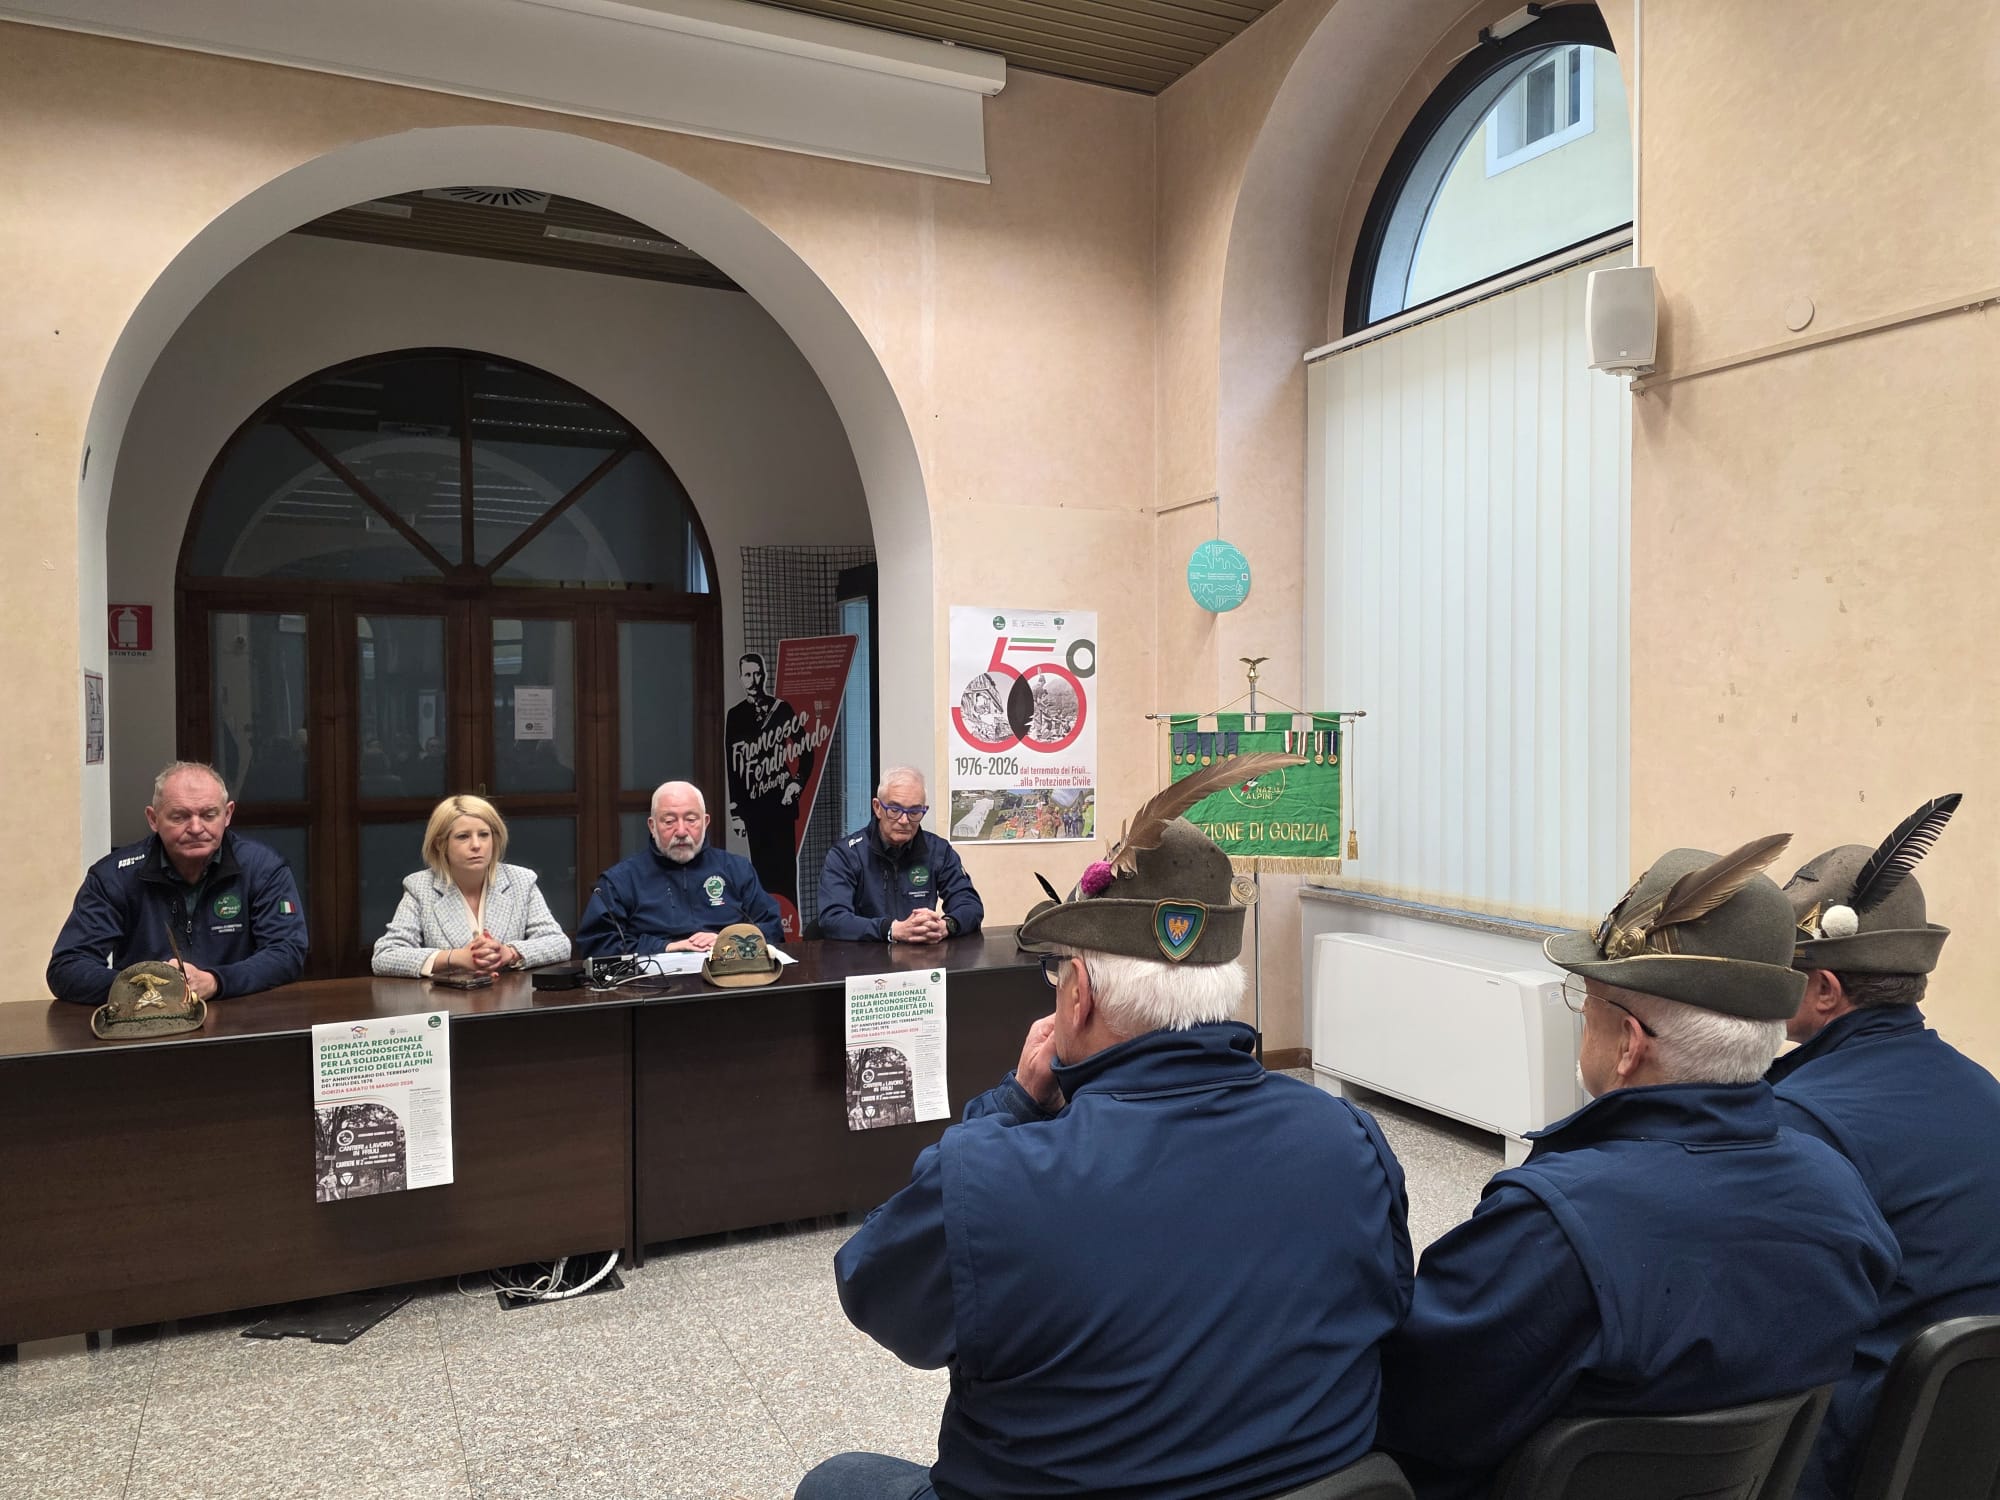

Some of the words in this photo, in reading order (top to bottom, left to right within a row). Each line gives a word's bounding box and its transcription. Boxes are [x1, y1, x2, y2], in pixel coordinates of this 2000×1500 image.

[732, 711, 809, 778] Francesco
[745, 719, 831, 790] Ferdinando
[955, 757, 1019, 776] 1976-2026
[1030, 767, 1060, 775] terremoto
[1034, 777, 1071, 787] Protezione
[1072, 776, 1091, 786] Civile
[1197, 822, 1245, 841] ZIONE
[1249, 822, 1264, 841] DI
[1269, 821, 1329, 842] GORIZIA
[851, 992, 888, 1001] GIORNATA
[888, 988, 927, 997] REGIONALE
[851, 1000, 872, 1008] DELLA
[872, 996, 927, 1006] RICONOSCENZA
[851, 1013, 891, 1022] SACRIFICIO
[891, 1010, 911, 1018] DEGLI
[911, 1008, 934, 1016] ALPINI
[874, 1002, 918, 1013] SOLIDARIETÀ
[320, 1041, 370, 1052] GIORNATA
[371, 1034, 423, 1046] REGIONALE
[320, 1050, 349, 1060] DELLA
[350, 1043, 423, 1057] RICONOSCENZA
[320, 1060, 338, 1068] PER
[340, 1059, 352, 1067] LA
[352, 1051, 412, 1065] SOLIDARIETÀ
[412, 1050, 425, 1058] ED
[320, 1064, 375, 1077] SACRIFICIO
[376, 1061, 402, 1071] DEGLI
[403, 1058, 433, 1067] ALPINI
[332, 1072, 375, 1083] ANNIVERSARIO
[386, 1067, 420, 1077] TERREMOTO
